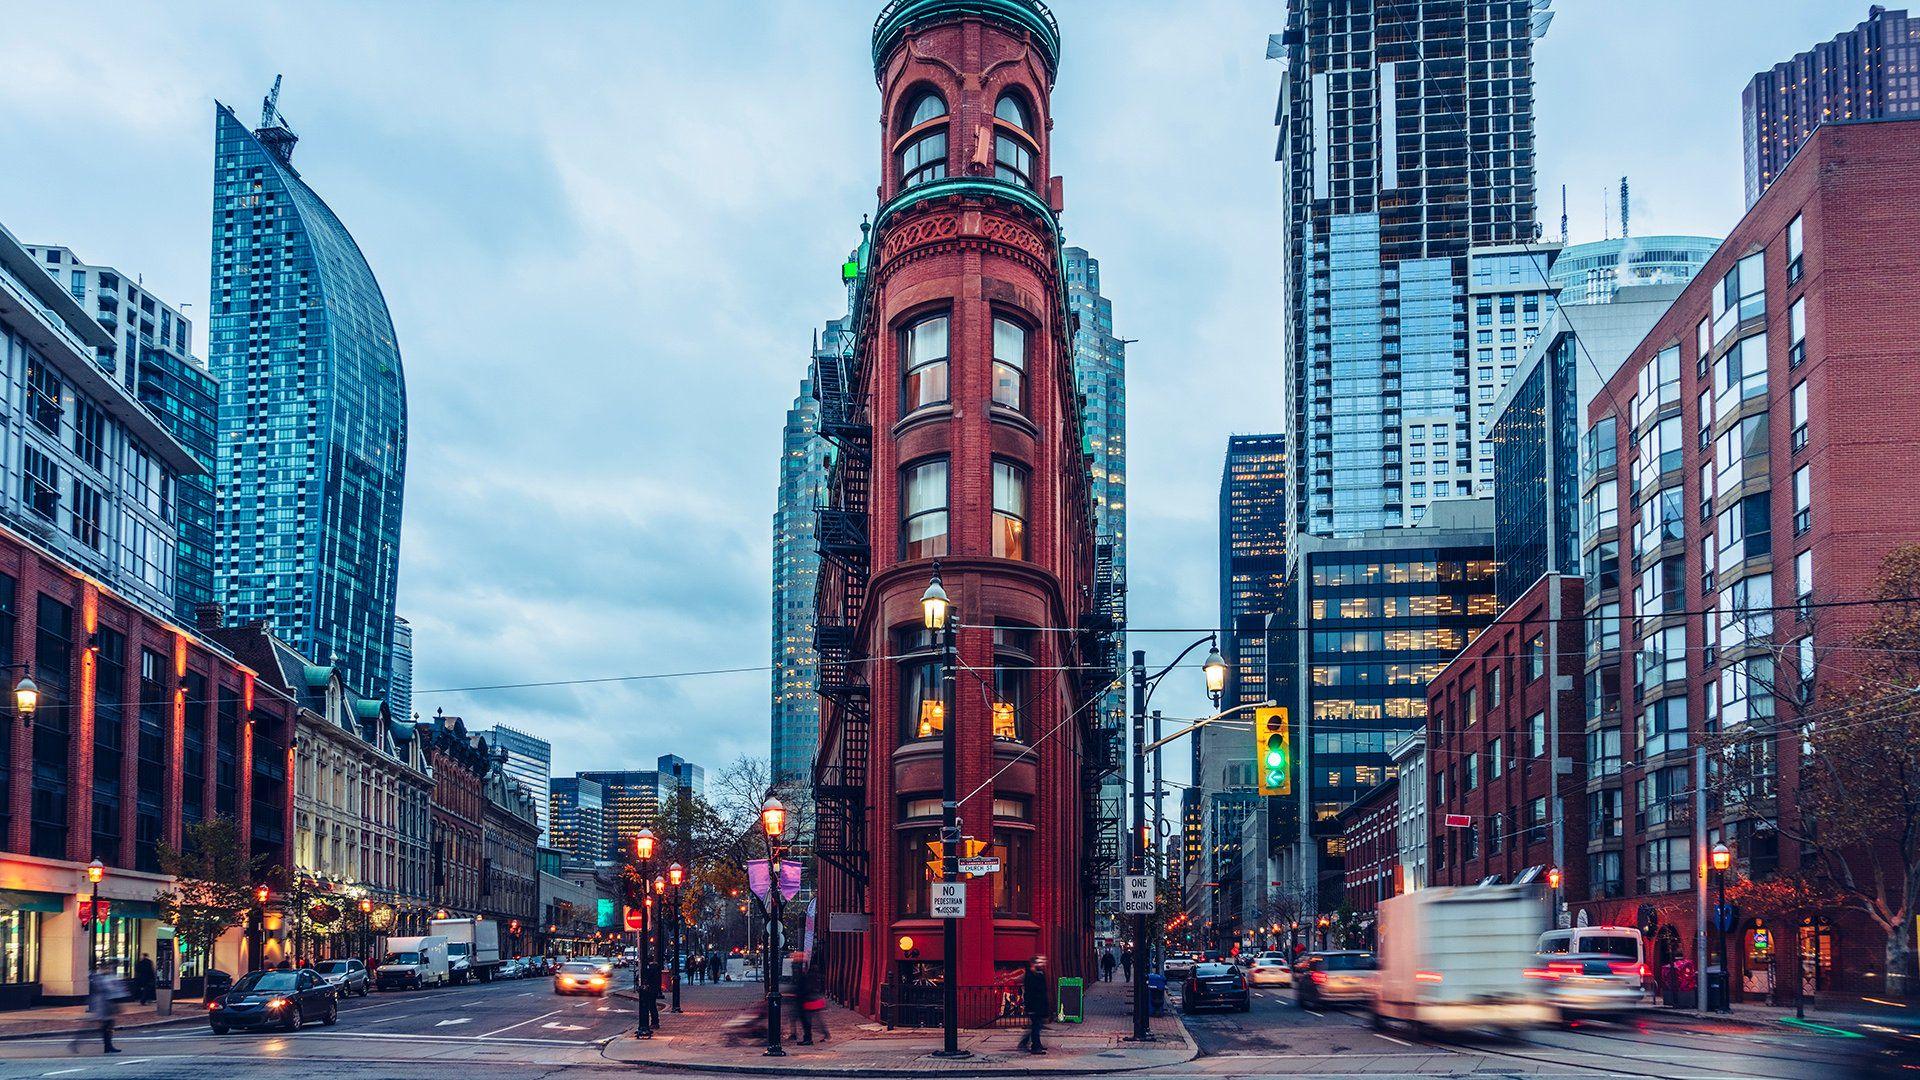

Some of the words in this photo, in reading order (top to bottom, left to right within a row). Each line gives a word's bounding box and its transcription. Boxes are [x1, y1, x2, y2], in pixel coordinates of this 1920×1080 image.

[1132, 879, 1147, 887] ONE
[943, 886, 955, 896] NO
[1132, 890, 1147, 899] WAY
[934, 897, 963, 905] PEDESTRIAN
[1126, 901, 1153, 911] BEGINS
